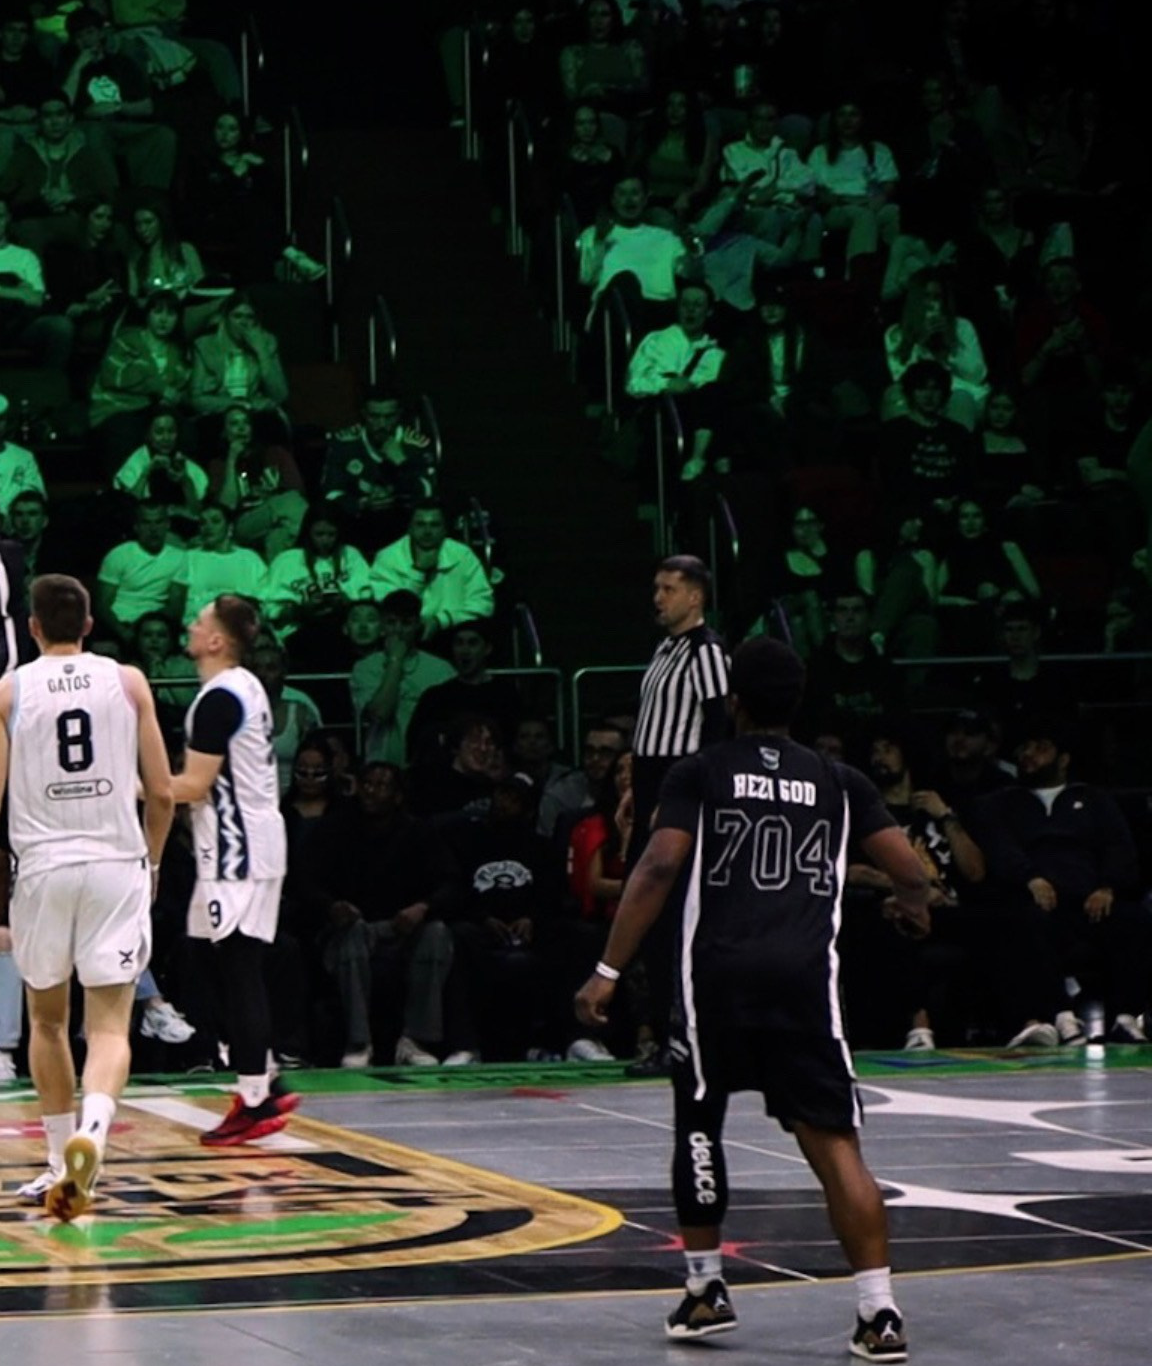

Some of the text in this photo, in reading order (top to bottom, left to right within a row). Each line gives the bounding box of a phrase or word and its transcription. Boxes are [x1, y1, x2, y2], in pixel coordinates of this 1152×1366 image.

[48, 674, 91, 694] GATOS
[56, 708, 94, 773] 8
[733, 773, 816, 807] HEZI GOD
[707, 808, 834, 896] 704
[208, 899, 222, 928] 9
[689, 1131, 717, 1205] deuce
